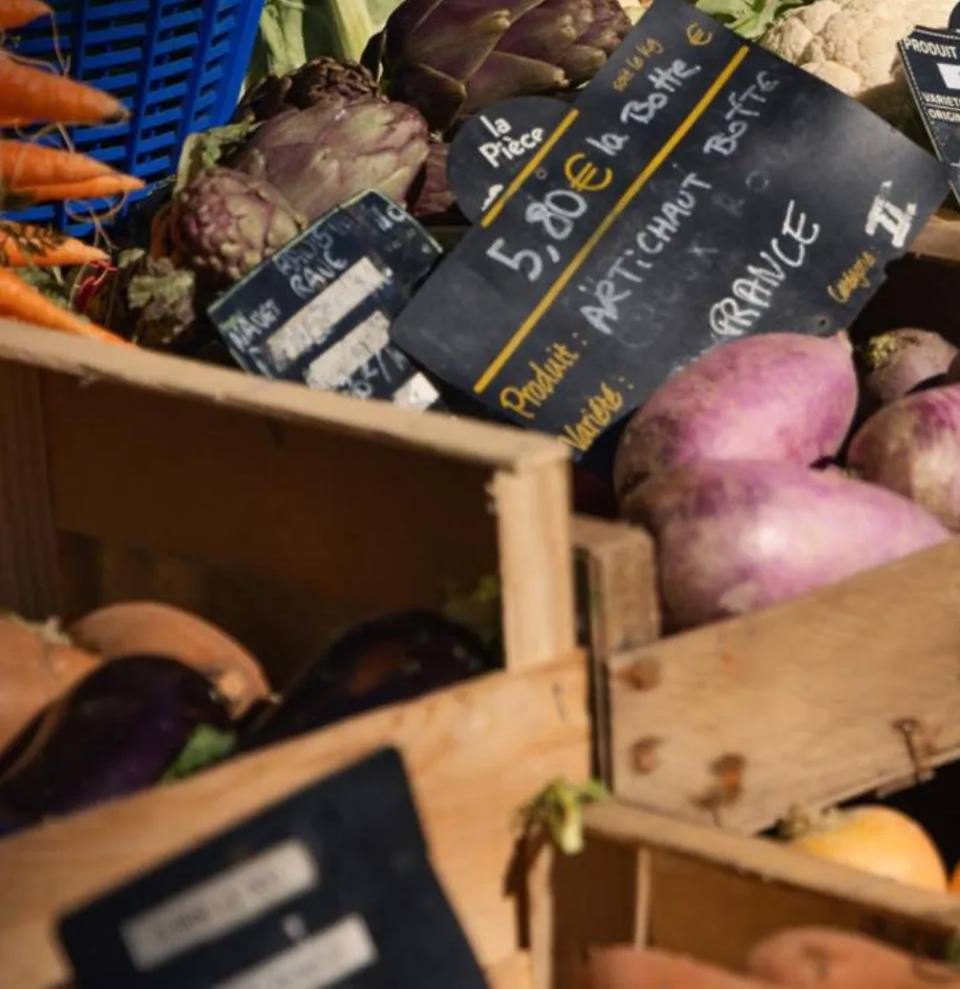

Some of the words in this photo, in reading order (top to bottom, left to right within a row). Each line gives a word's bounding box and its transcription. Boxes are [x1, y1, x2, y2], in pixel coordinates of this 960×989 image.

[684, 22, 714, 48] €
[903, 37, 959, 60] PRODUIT
[479, 115, 512, 137] la
[478, 125, 545, 169] Pièce
[586, 130, 630, 159] la
[709, 198, 821, 337] FRANCE
